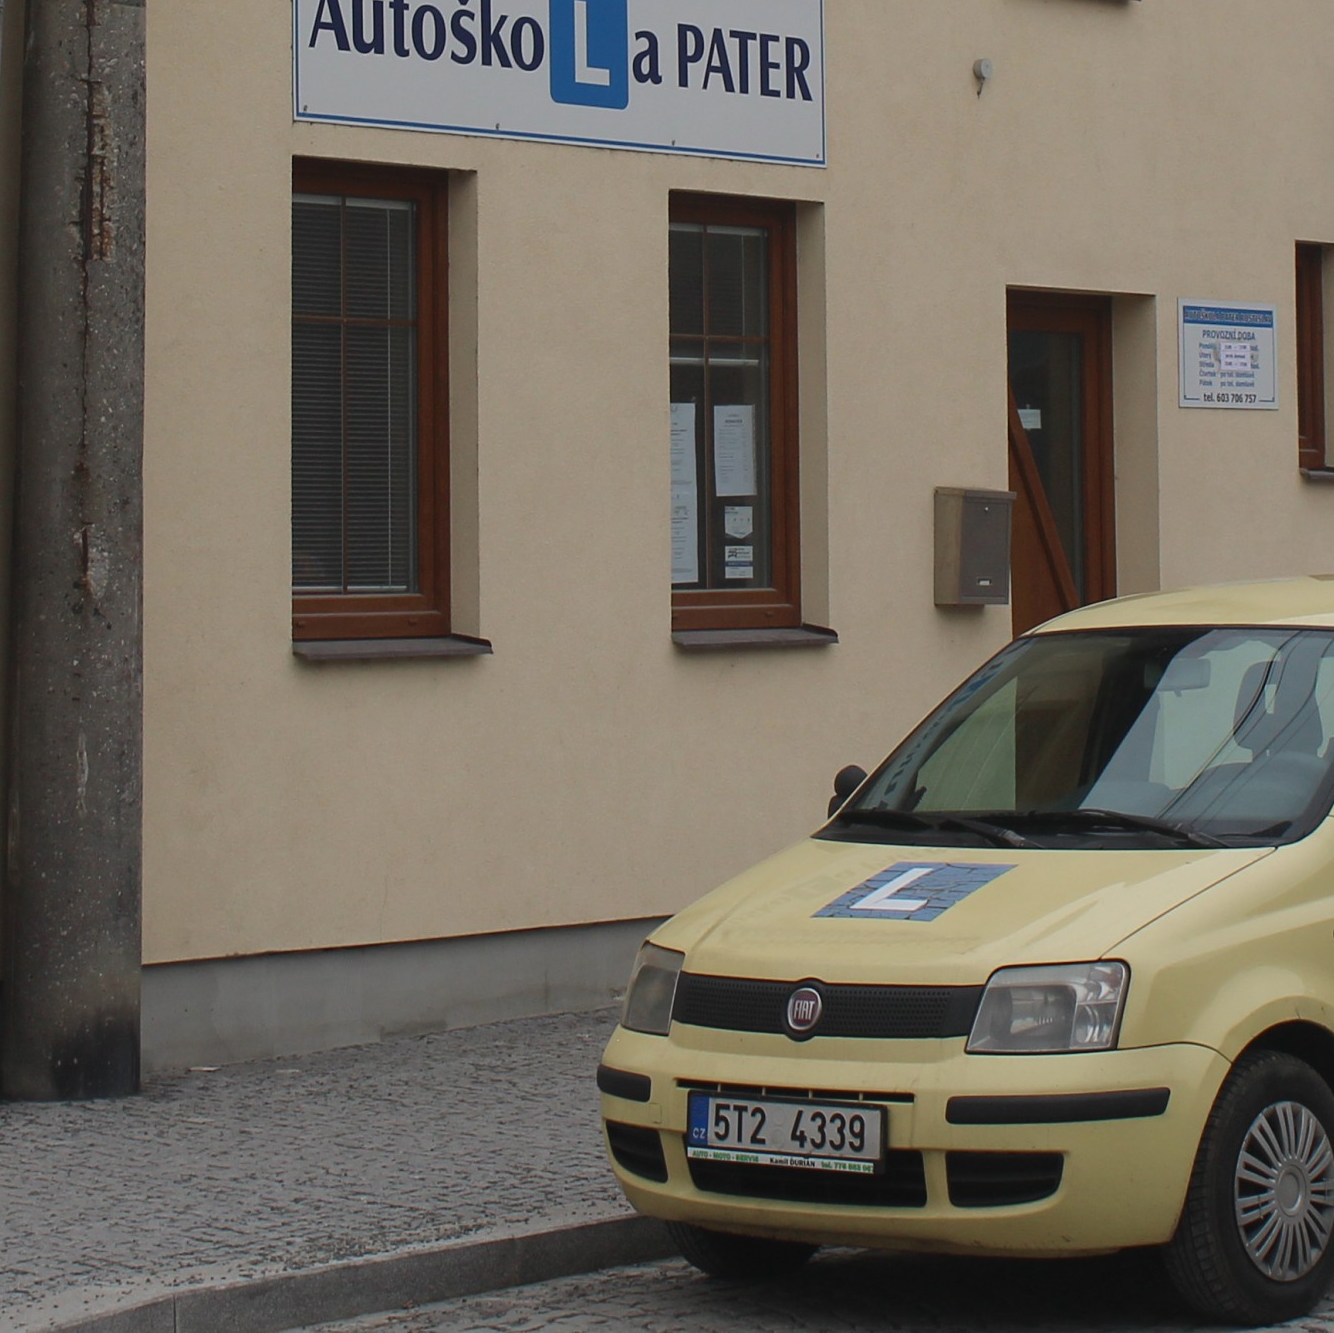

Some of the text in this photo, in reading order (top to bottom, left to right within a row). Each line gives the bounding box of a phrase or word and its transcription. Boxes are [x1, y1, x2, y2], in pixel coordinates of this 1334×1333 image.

[677, 23, 813, 102] PATER
[1202, 329, 1256, 341] PROVOZNÍ DOBA
[1203, 392, 1257, 404] tel. 603 706 757
[849, 867, 934, 912] L
[793, 1000, 816, 1020] FIAT
[692, 1102, 866, 1152] CZ 5T2 4339
[769, 1157, 789, 1165] Kamil
